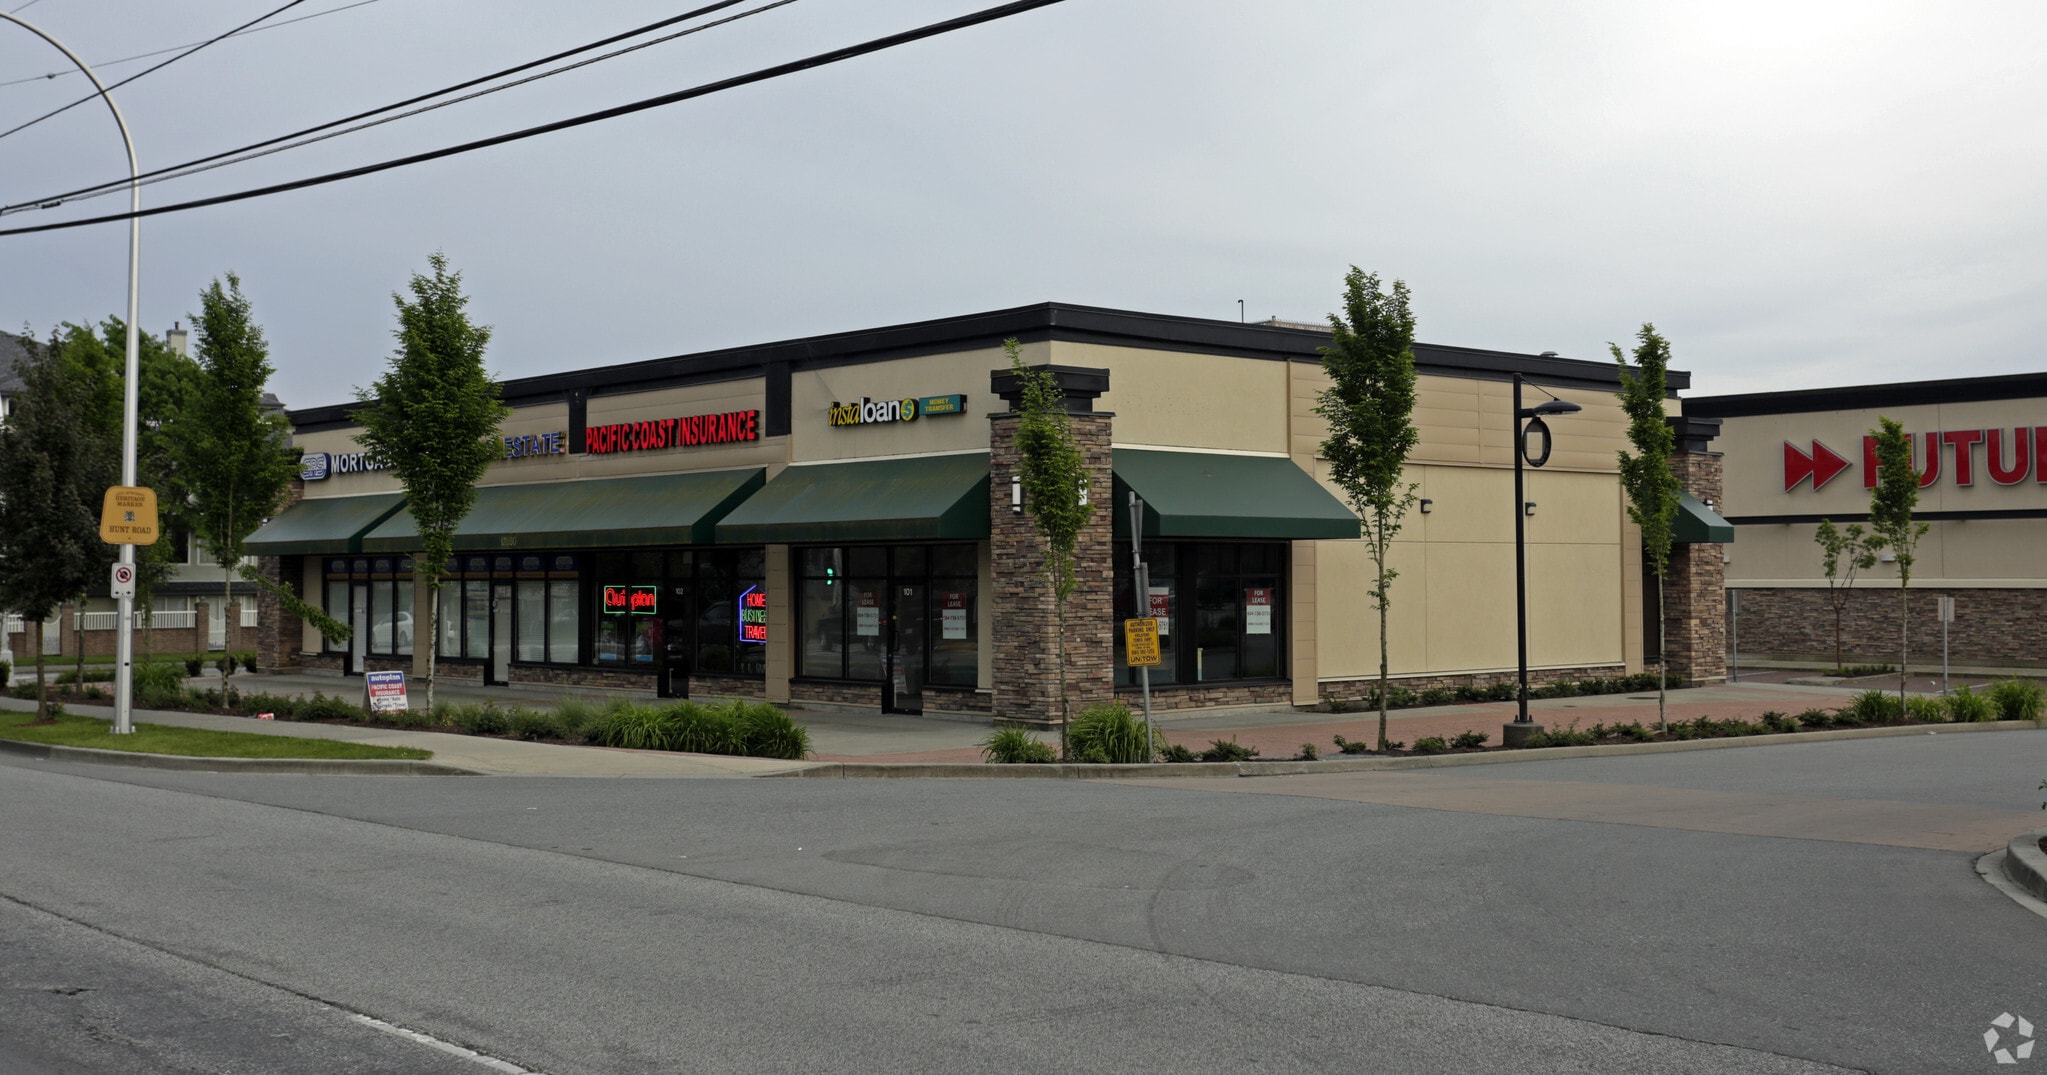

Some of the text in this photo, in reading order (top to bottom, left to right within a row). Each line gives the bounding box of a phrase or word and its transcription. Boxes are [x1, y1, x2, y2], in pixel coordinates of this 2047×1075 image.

[925, 404, 954, 412] TRANSFER
[586, 410, 756, 455] PACIFIC COAST INSURANCE
[503, 432, 561, 458] ESTATE
[1862, 427, 2047, 489] FUTU
[109, 525, 152, 534] HUNT ROAD
[747, 593, 766, 607] HOME
[1149, 607, 1166, 616] EASE
[371, 674, 401, 682] autoplan
